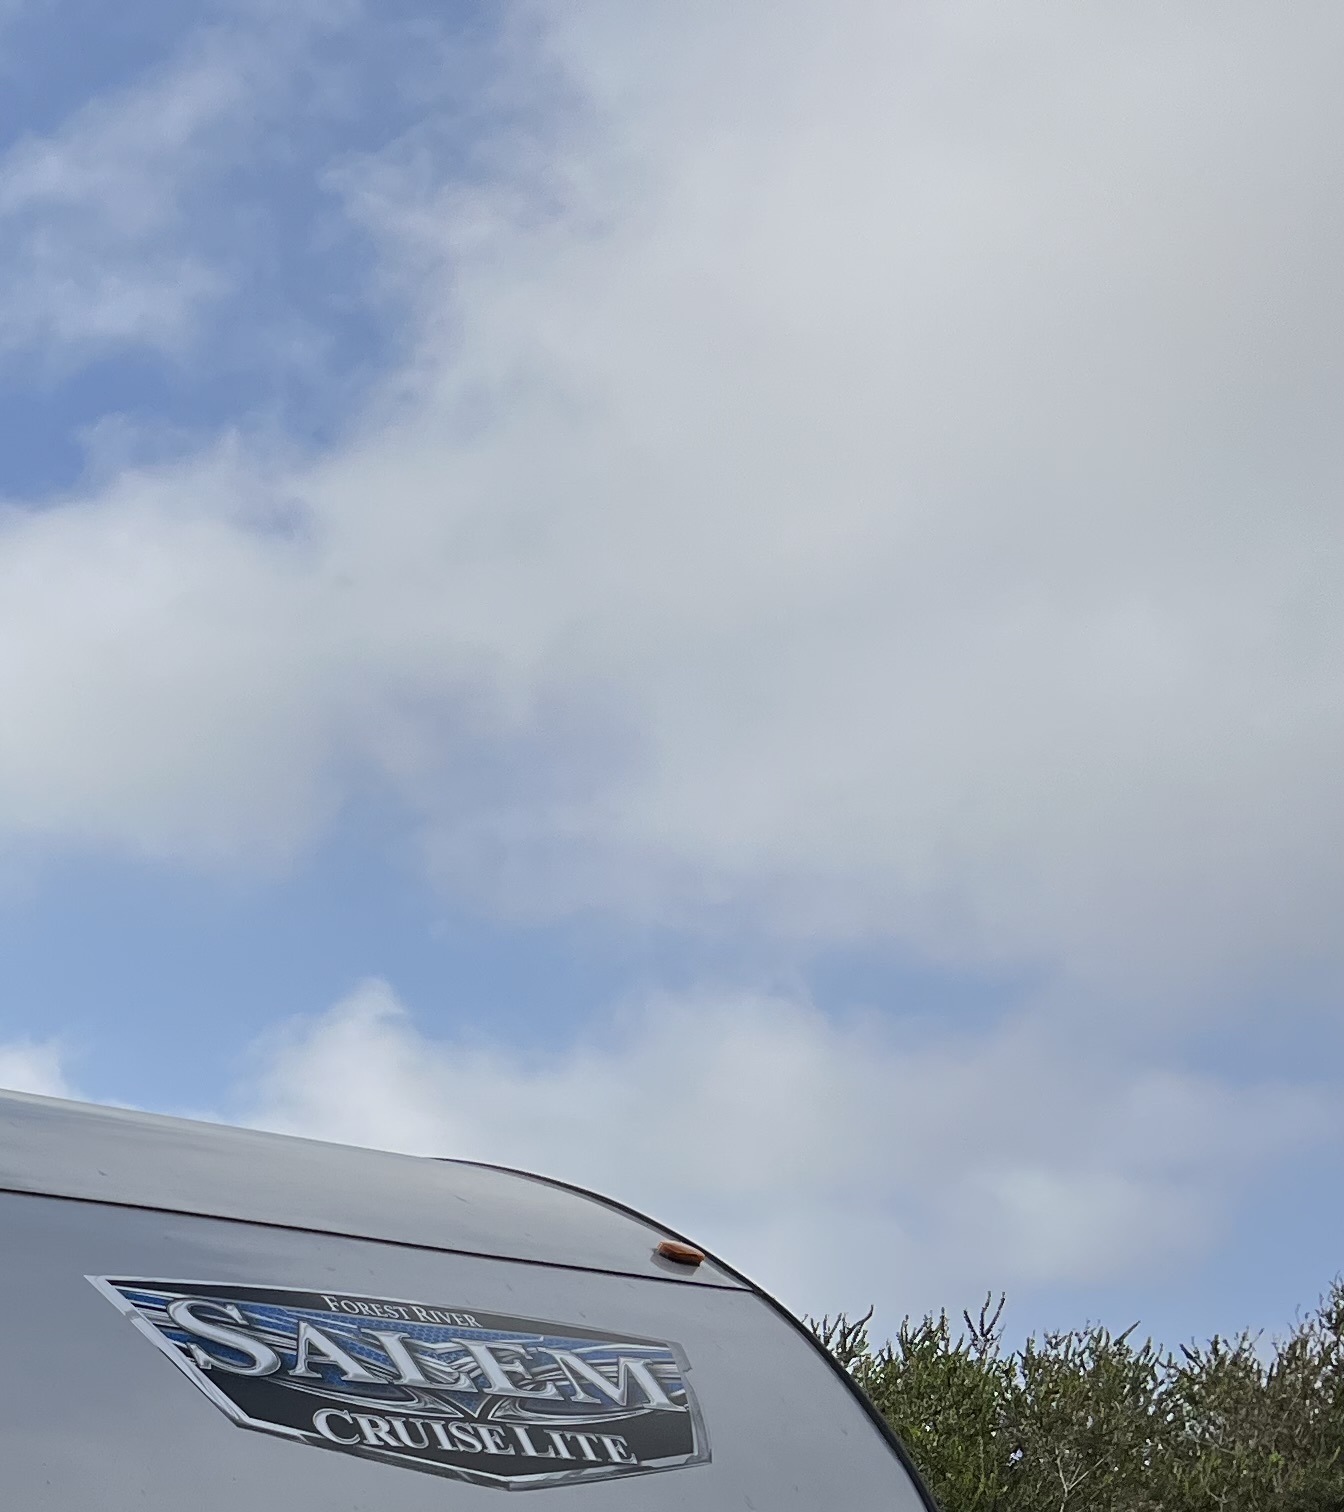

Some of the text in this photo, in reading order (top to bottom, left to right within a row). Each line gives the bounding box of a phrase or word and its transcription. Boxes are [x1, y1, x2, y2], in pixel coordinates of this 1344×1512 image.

[320, 1295, 484, 1328] FOREST RIVER
[164, 1296, 689, 1413] SALEM
